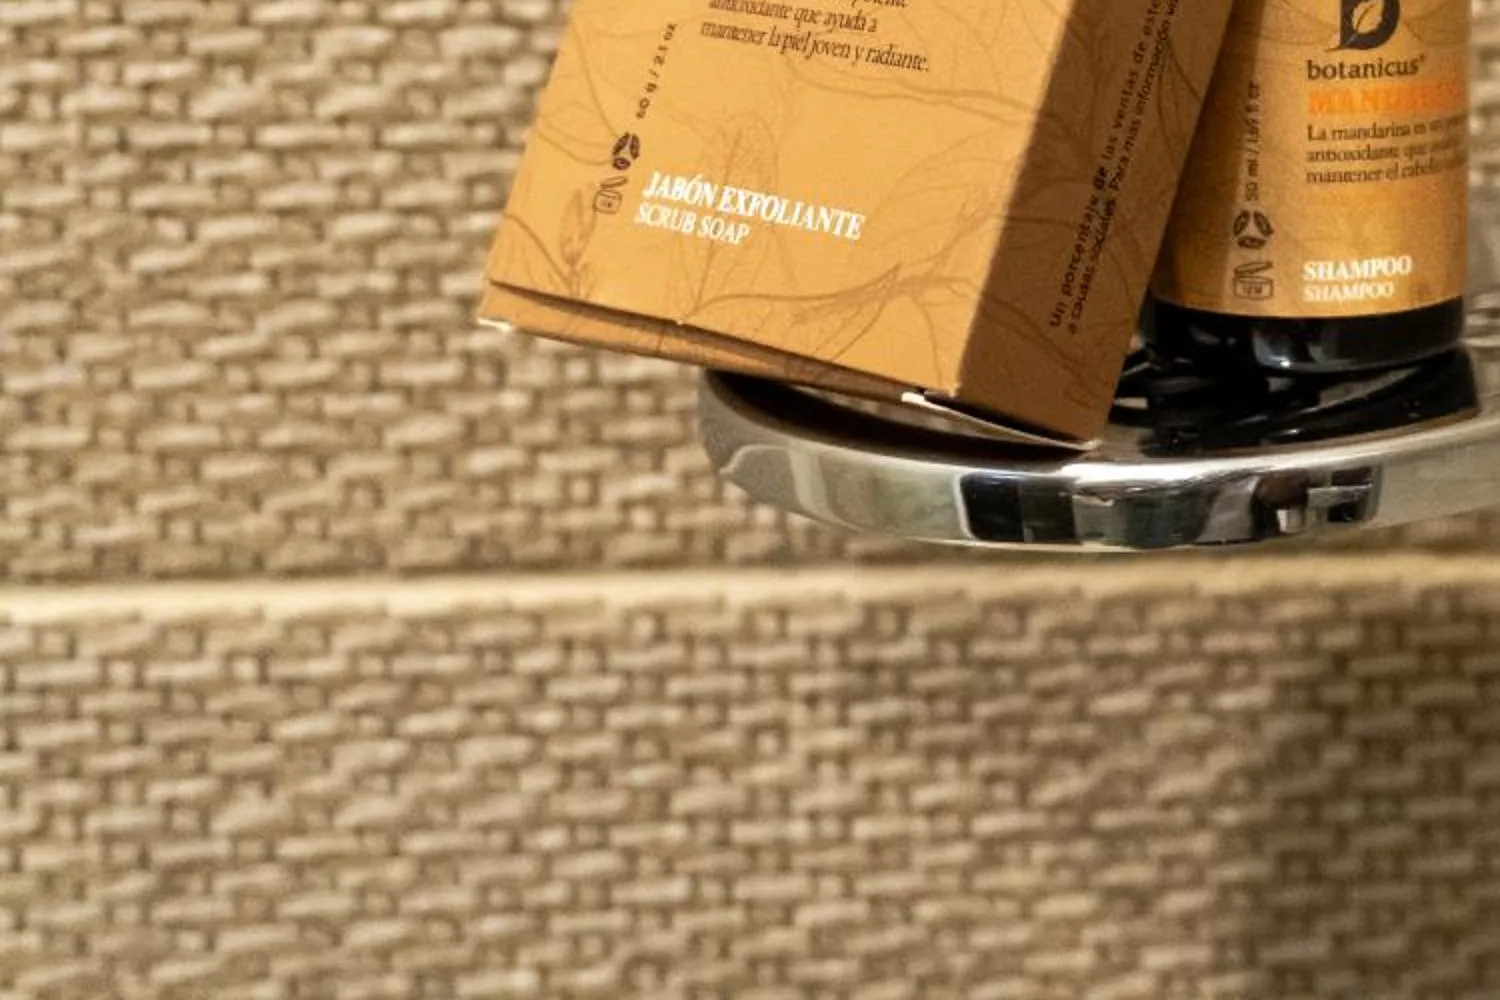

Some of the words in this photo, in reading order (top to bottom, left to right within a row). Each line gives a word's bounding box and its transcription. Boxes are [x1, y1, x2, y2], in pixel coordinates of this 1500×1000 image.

[794, 6, 819, 31] que
[823, 9, 867, 33] ayuda
[868, 18, 877, 33] a
[701, 21, 768, 45] mantener
[768, 25, 782, 47] la
[781, 31, 811, 55] piel
[805, 37, 851, 60] joven
[851, 48, 865, 68] y
[865, 43, 929, 72] radiante.
[1132, 41, 1147, 65] de
[1306, 58, 1419, 80] botanicus
[1112, 70, 1140, 130] ventas
[1307, 124, 1326, 141] La
[1331, 121, 1411, 141] mandarina
[1100, 136, 1118, 161] las
[1092, 166, 1109, 191] de
[1306, 168, 1382, 183] mantener
[1385, 161, 1399, 181] el
[642, 170, 718, 208] JABÓN
[719, 184, 866, 241] EXFOLIANTE
[634, 202, 697, 234] SCRUB
[697, 214, 751, 245] SOAP
[1303, 255, 1412, 281] SHAMPOO
[1303, 282, 1395, 302] SHAMPOO
[1048, 301, 1067, 327] Un
